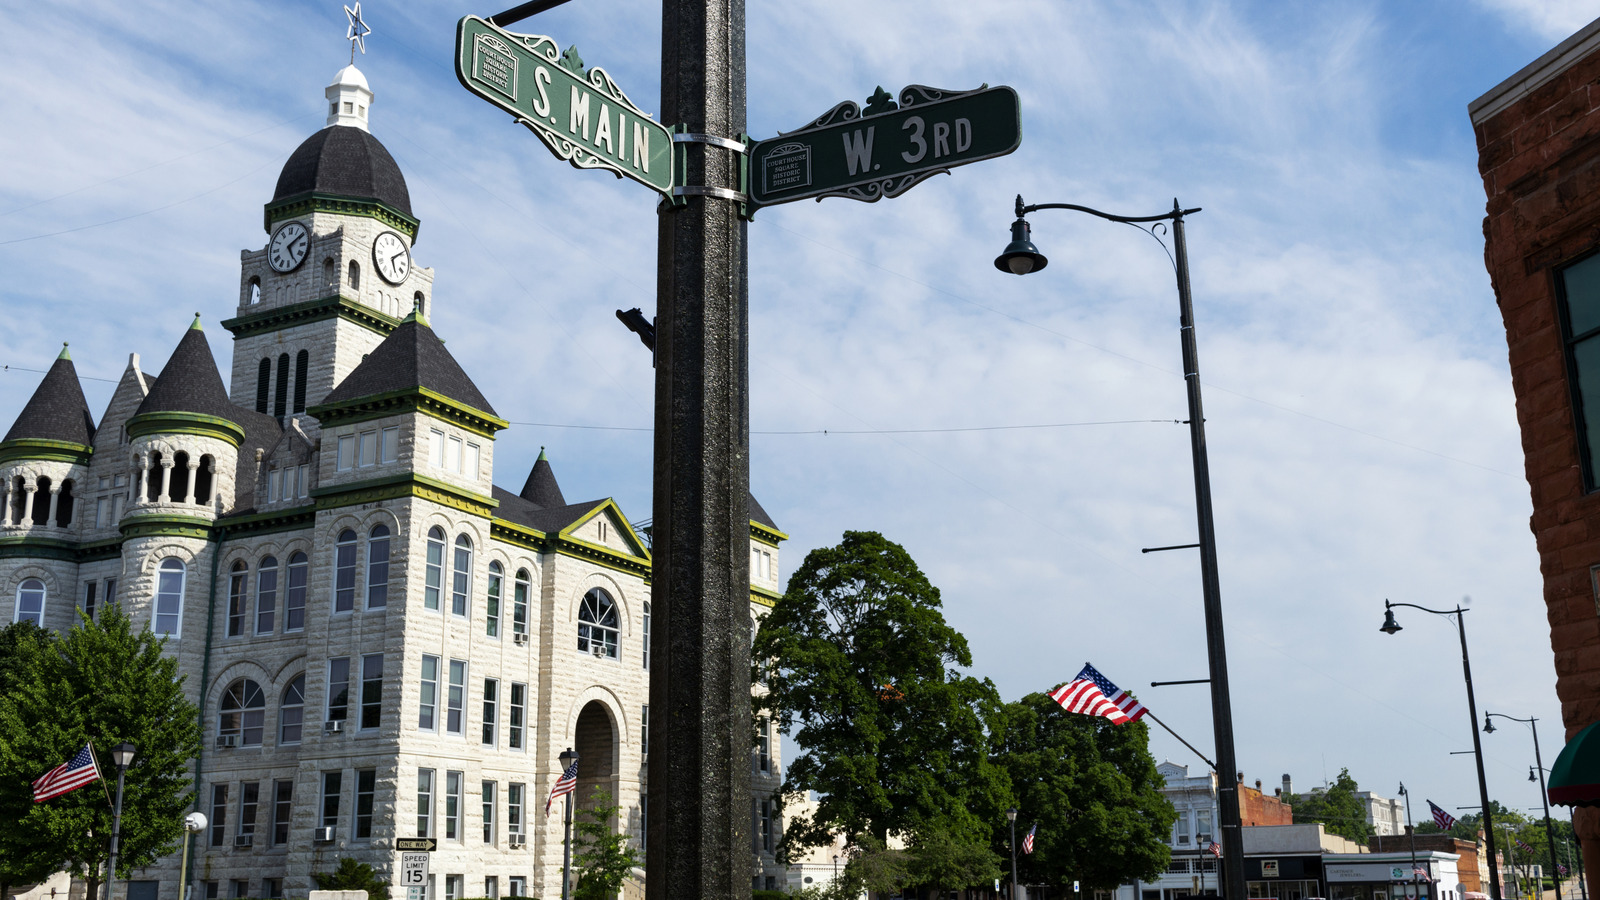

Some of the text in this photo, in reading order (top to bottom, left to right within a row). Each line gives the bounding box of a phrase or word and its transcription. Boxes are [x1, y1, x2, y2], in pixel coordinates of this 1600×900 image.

[478, 44, 515, 70] COURTHOUSE
[485, 56, 507, 73] SQUARE
[482, 70, 508, 89] DISTRICT
[483, 62, 509, 81] HISTORIC
[532, 66, 649, 174] S. MAIN
[842, 115, 972, 176] W. 3RD
[767, 154, 807, 168] COURTHOUSE
[775, 162, 799, 173] SQUARE
[772, 168, 801, 180] HISTORIC
[773, 175, 801, 187] DISTRICT
[406, 870, 423, 882] 15
